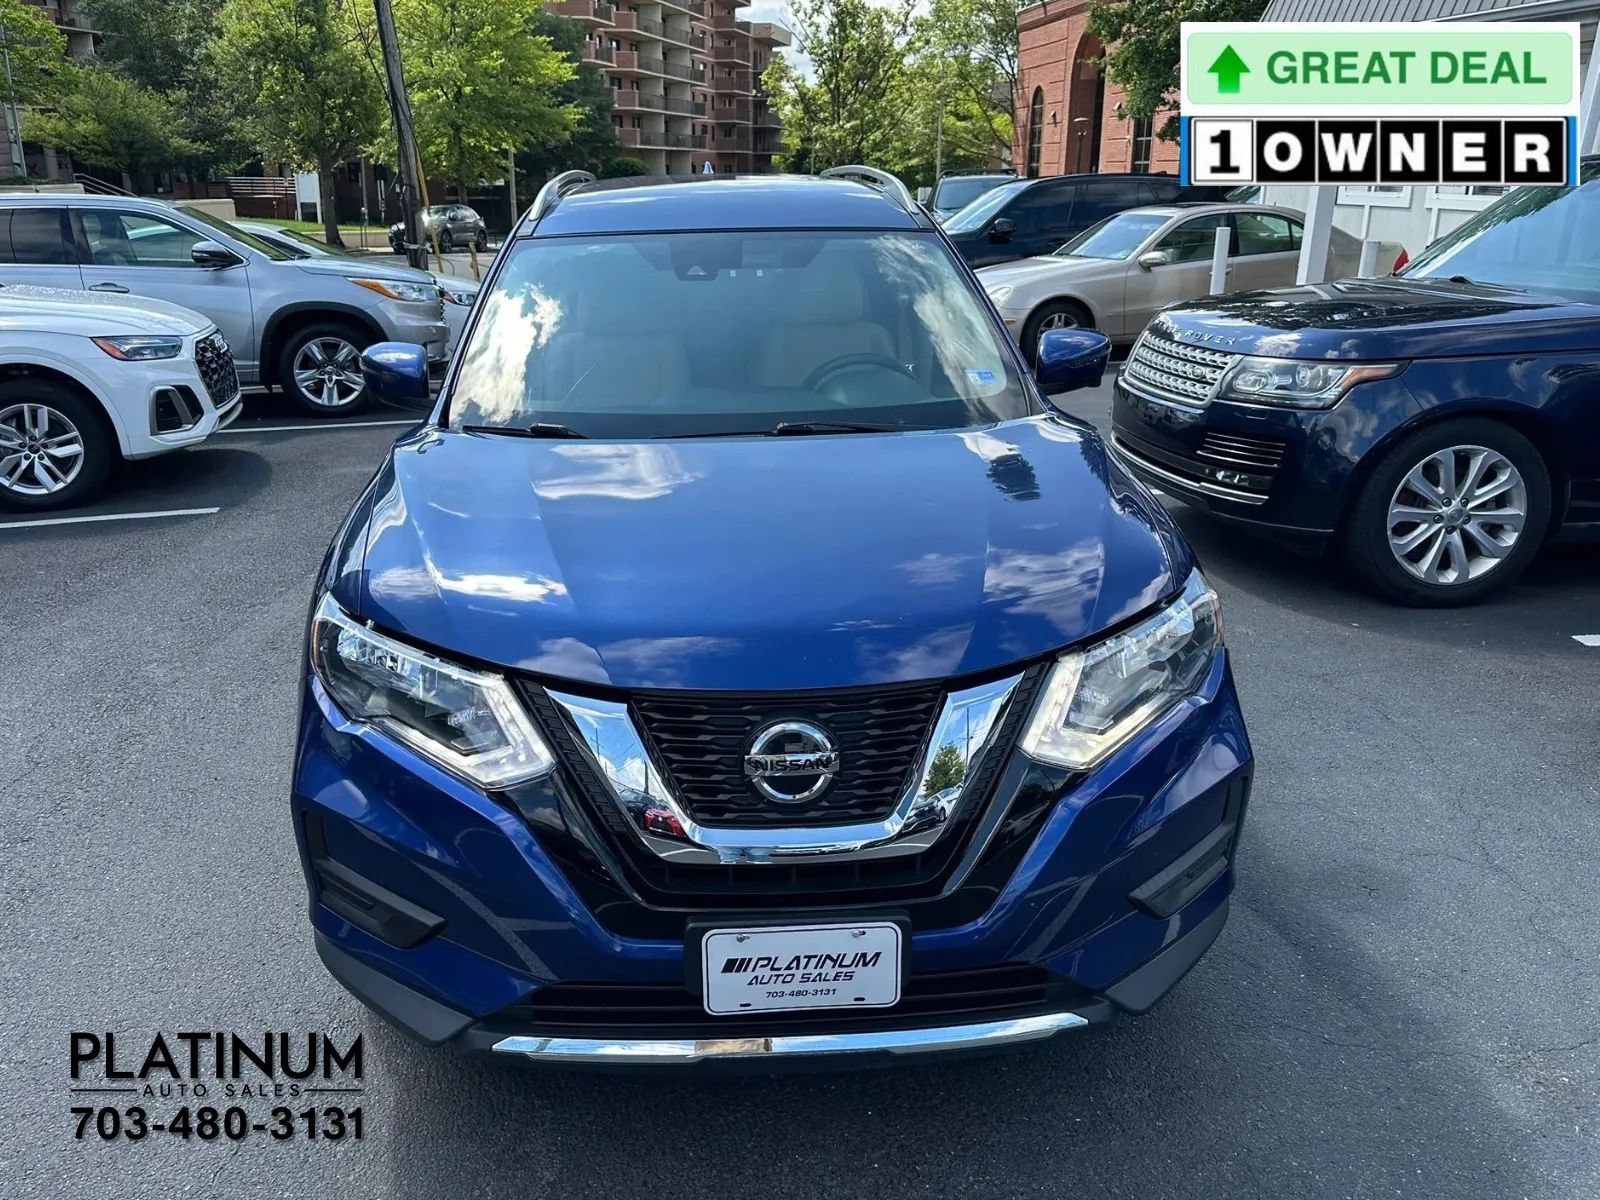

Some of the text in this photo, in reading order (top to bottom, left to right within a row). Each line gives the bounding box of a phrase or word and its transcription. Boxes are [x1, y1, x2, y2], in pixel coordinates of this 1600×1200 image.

[1184, 329, 1236, 346] ROVER
[748, 755, 834, 772] NISSAN
[751, 951, 882, 973] PLATINUM
[746, 971, 856, 986] AUTO SALES
[765, 988, 837, 999] 703-480-3131
